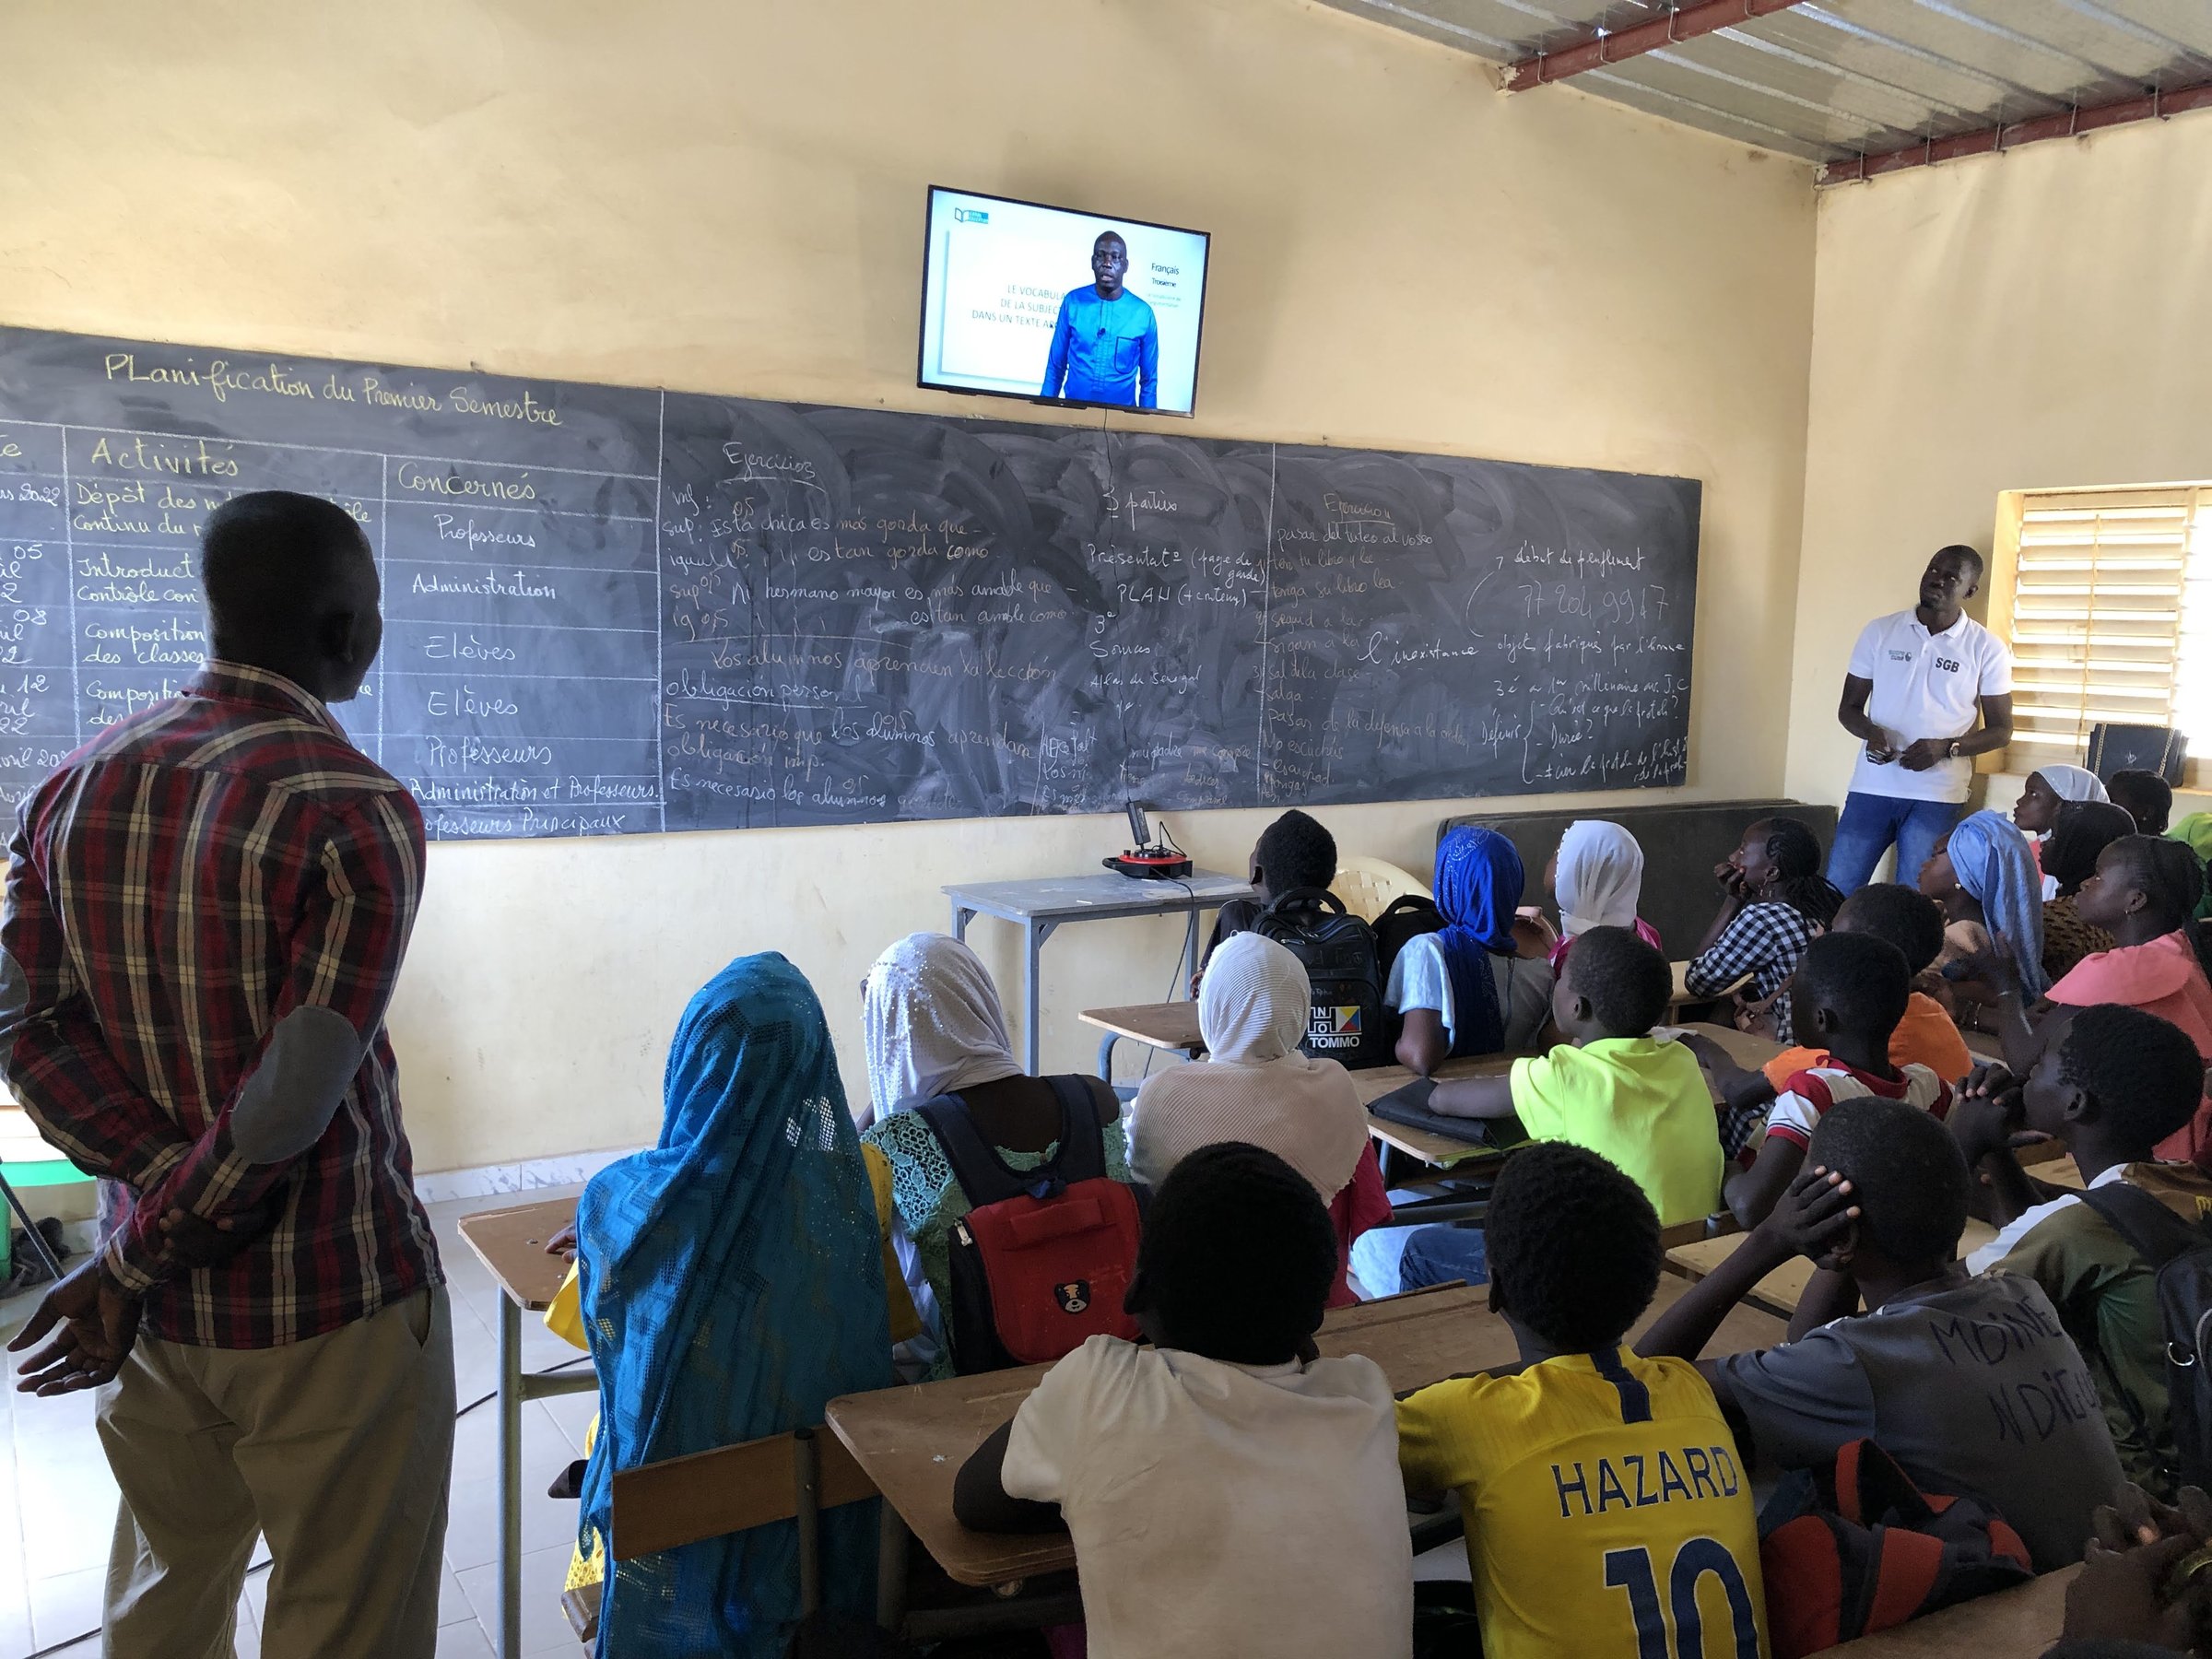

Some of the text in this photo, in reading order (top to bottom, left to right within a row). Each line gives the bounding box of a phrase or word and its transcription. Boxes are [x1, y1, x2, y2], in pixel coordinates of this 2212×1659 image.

[1151, 263, 1180, 276] Français
[1007, 284, 1017, 294] LE
[1000, 299, 1011, 308] DE
[1014, 301, 1025, 310] LA
[971, 310, 996, 321] DANS
[999, 313, 1013, 324] UN
[1016, 315, 1041, 328] TEXTE
[323, 374, 356, 402] du
[362, 377, 442, 411] Premier
[449, 386, 564, 426] Semestre
[92, 437, 239, 477] Activités
[398, 462, 536, 500] Concernés
[76, 480, 146, 518] Dépôt
[158, 487, 197, 509] des
[158, 512, 187, 534] du
[433, 513, 536, 550] Professeurs
[761, 509, 806, 533] chica
[840, 506, 867, 530] más
[877, 509, 931, 545] gorda
[939, 518, 968, 544] que
[1382, 526, 1398, 544] al
[14, 544, 42, 559] 05
[835, 537, 875, 559] tan
[888, 534, 938, 570] gorda
[412, 569, 556, 599] Administration
[846, 589, 898, 611] mayor
[1029, 580, 1053, 603] que
[82, 643, 205, 664] des classes
[1936, 657, 1960, 673] SGB
[18, 675, 50, 694] 12
[426, 735, 553, 772] Professeurs
[409, 776, 538, 803] Administration
[544, 778, 561, 800] et
[1317, 1007, 1326, 1017] N
[1310, 1036, 1360, 1049] TOMMO
[1550, 1446, 1739, 1518] HAZARD
[1603, 1535, 1761, 1659] 10
